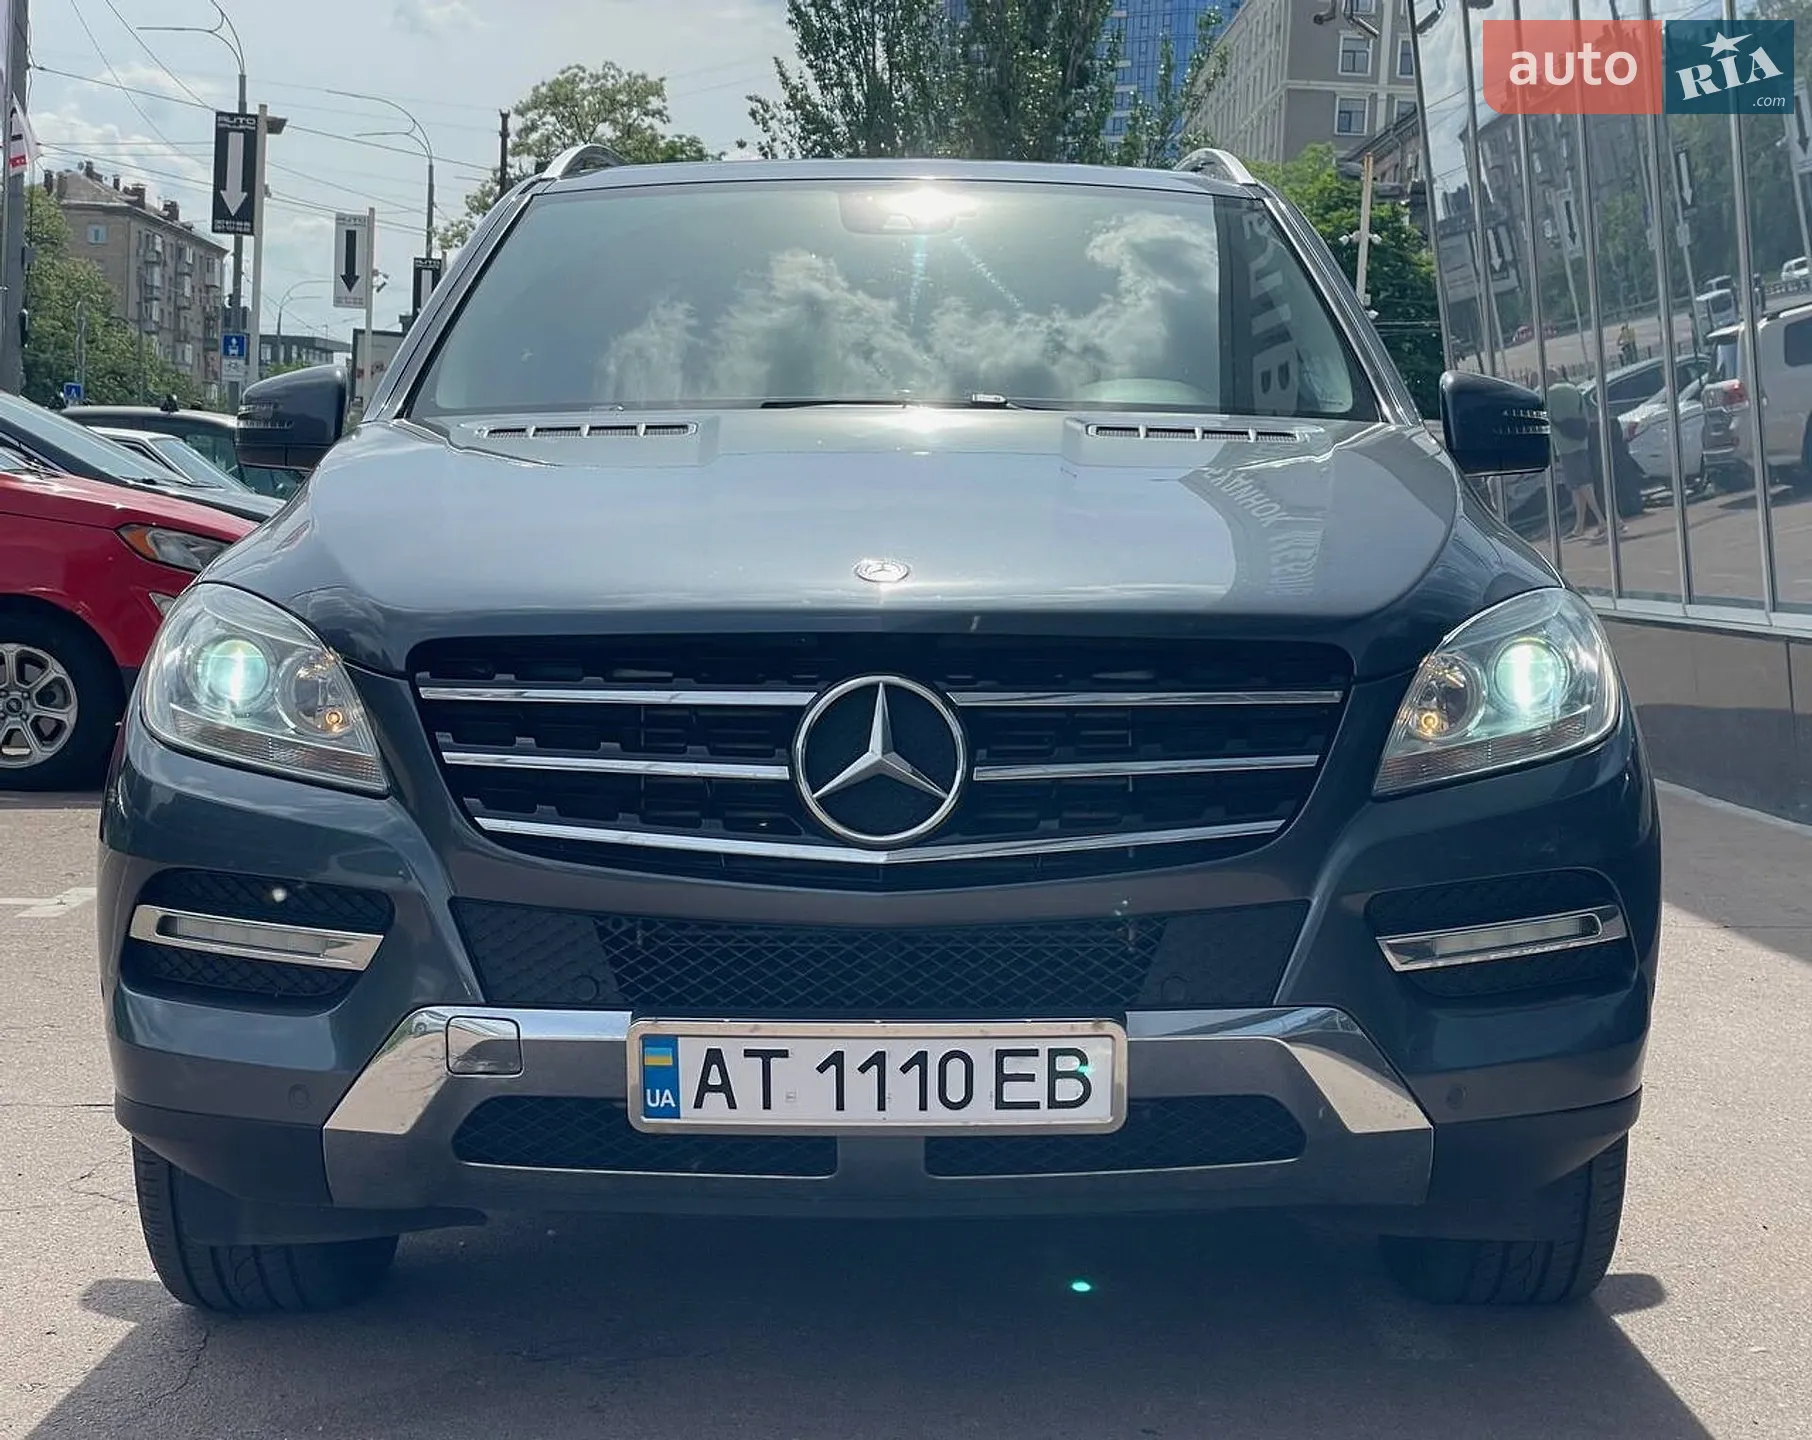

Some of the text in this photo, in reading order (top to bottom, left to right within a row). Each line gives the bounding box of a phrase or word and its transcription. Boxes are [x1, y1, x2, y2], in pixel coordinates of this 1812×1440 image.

[645, 1088, 676, 1108] UA
[692, 1047, 1093, 1112] AT 1110 EB
